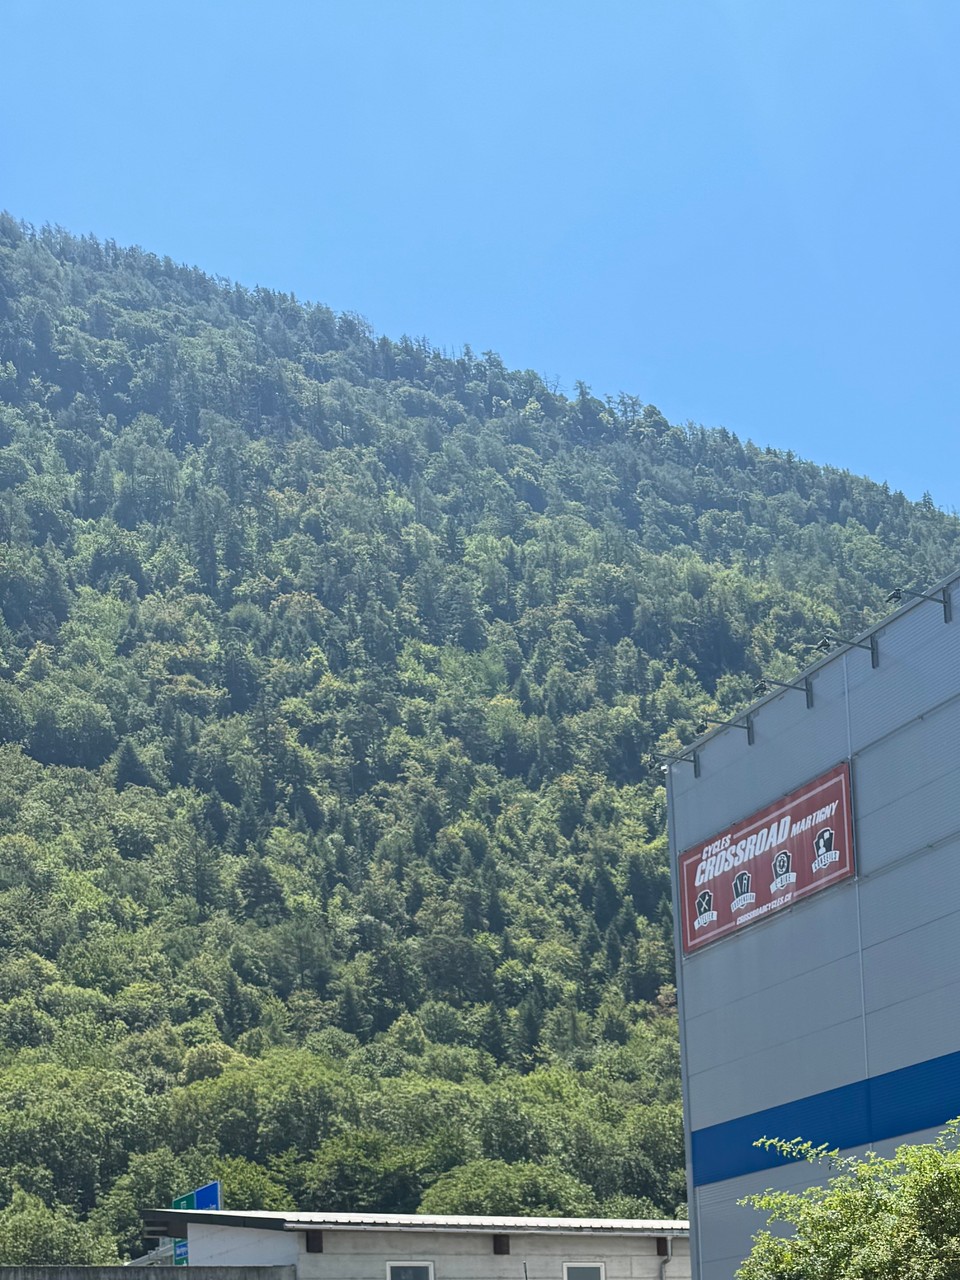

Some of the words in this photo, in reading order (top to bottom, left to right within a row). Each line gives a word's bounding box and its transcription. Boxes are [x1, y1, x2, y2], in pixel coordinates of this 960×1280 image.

[694, 815, 791, 887] CROSSROAD
[790, 800, 839, 838] MARTIGNY
[702, 833, 732, 860] CYCLES
